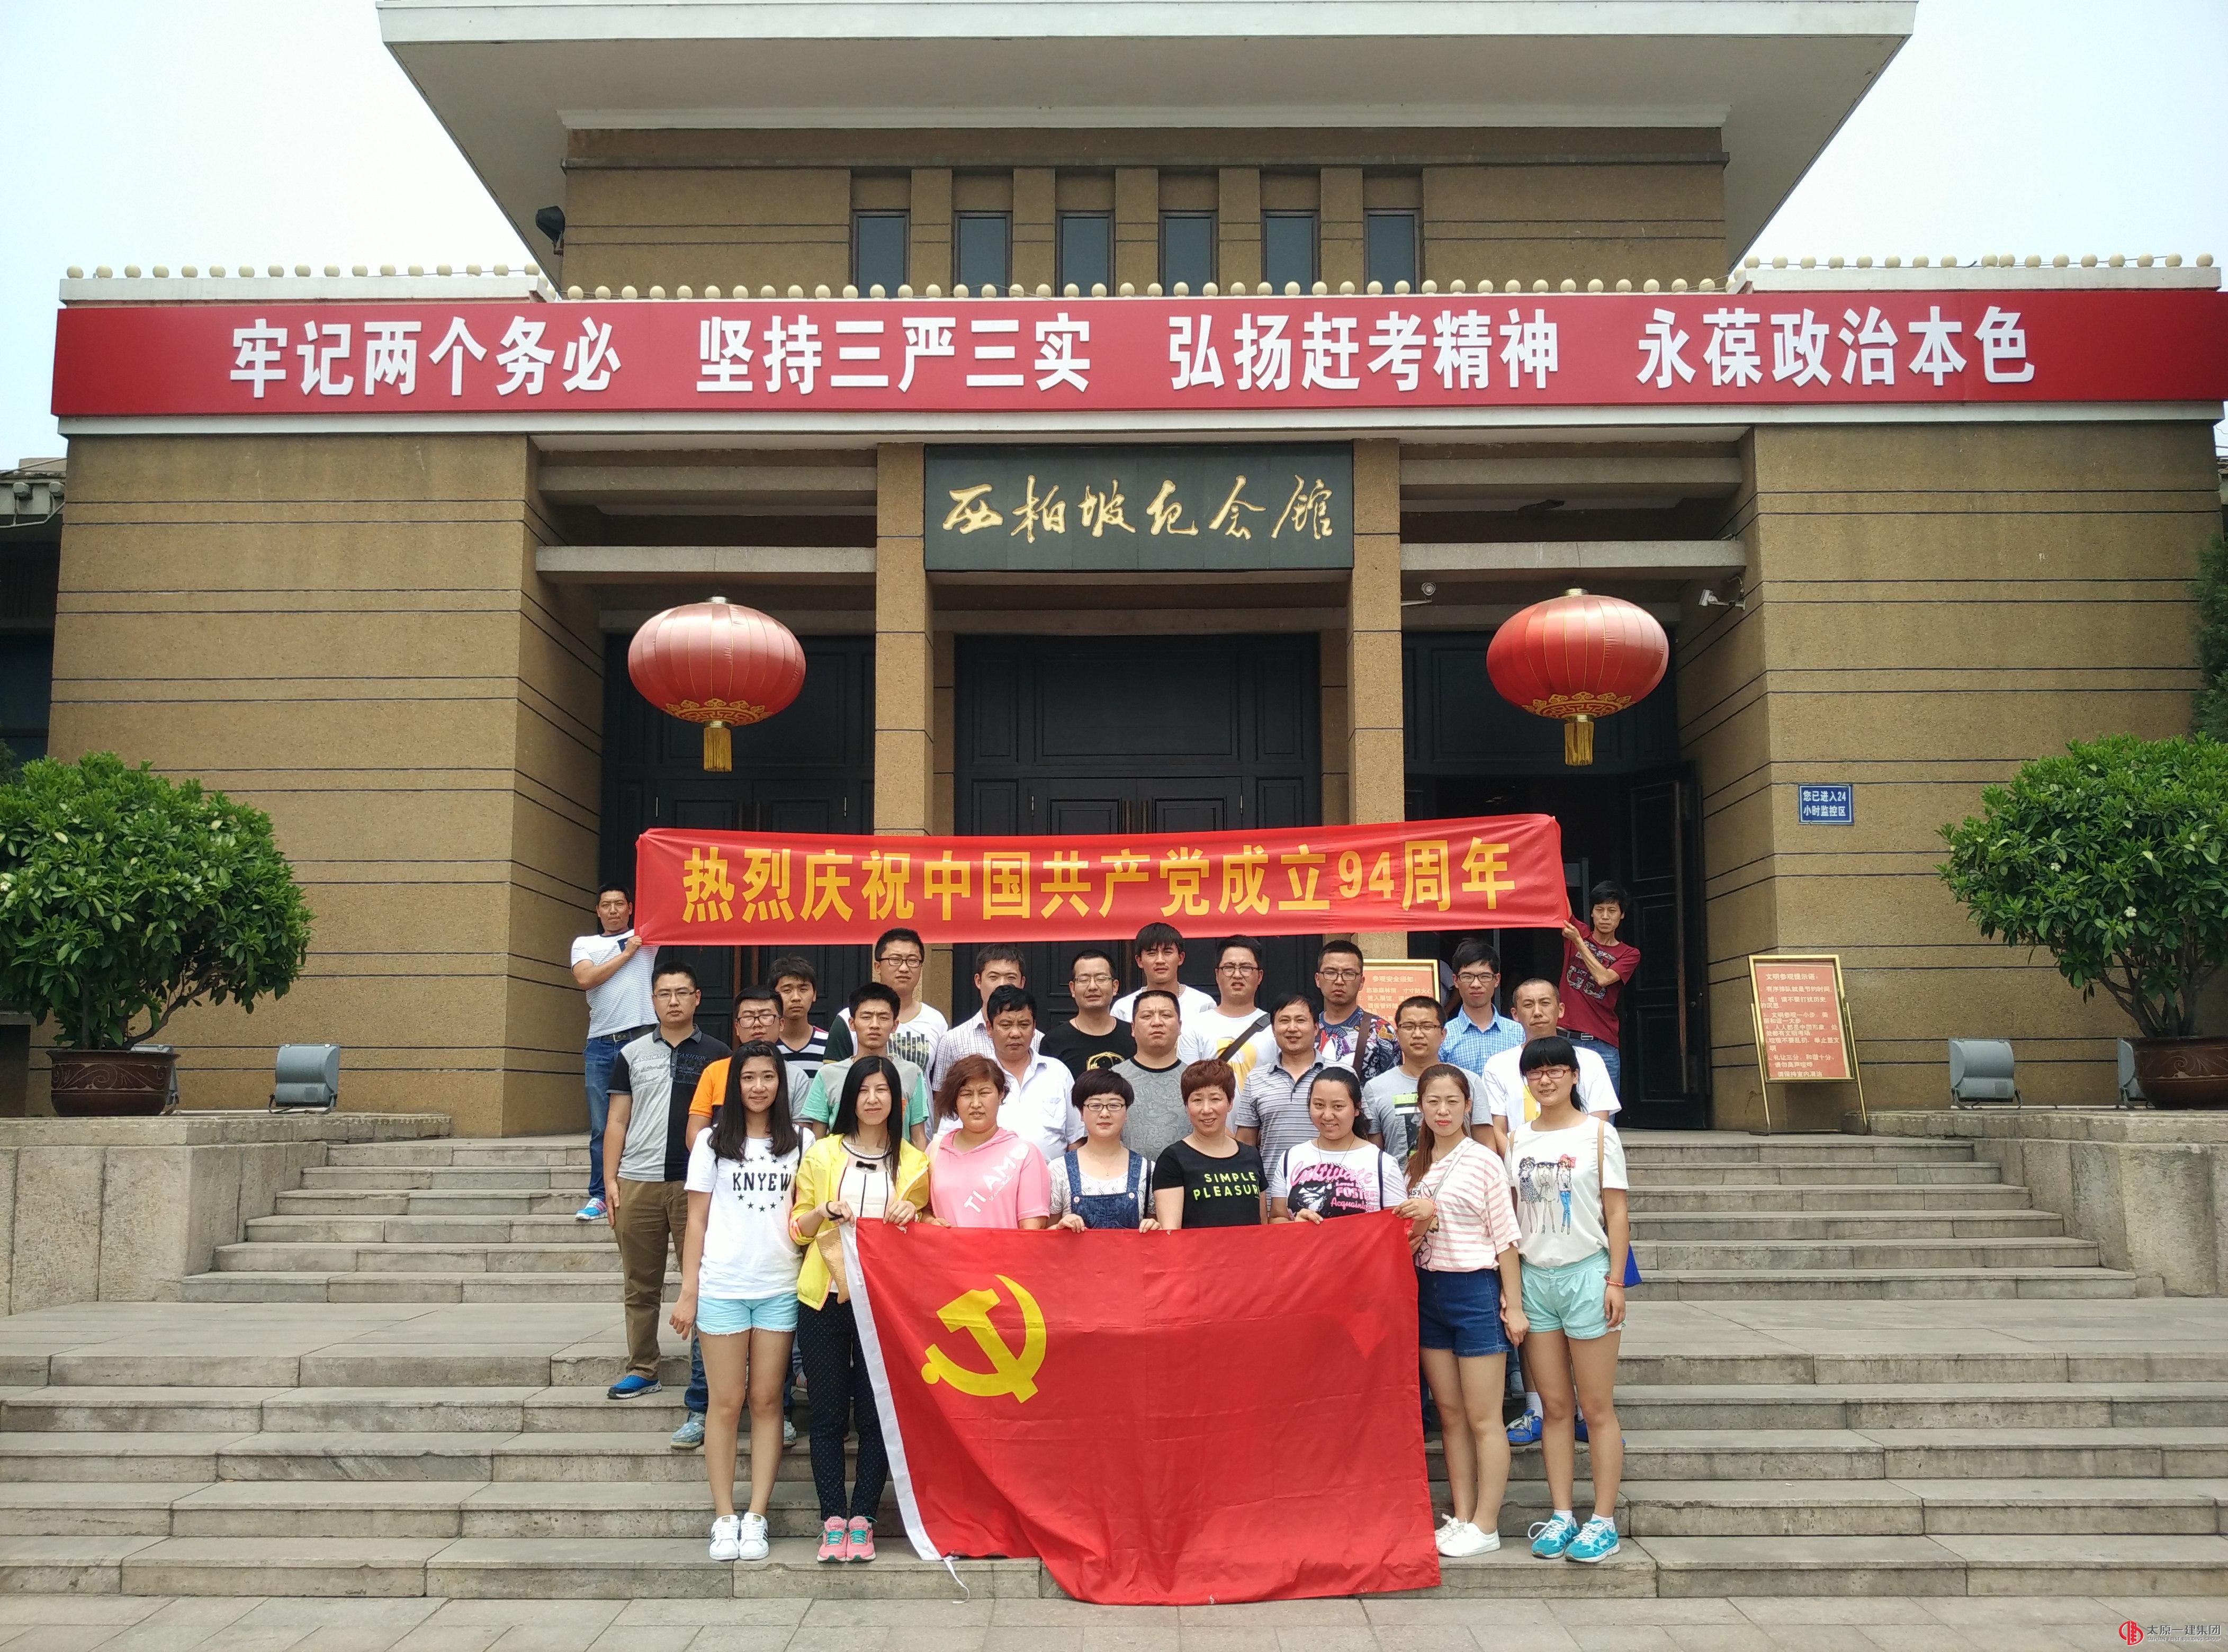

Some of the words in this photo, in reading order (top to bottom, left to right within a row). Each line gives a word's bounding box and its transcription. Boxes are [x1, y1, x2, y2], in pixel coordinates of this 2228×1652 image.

[230, 315, 622, 398] 牢记两个务必
[696, 312, 1091, 394] 坚持三严三实
[1168, 308, 1559, 392] 弘扬赶考精神
[1636, 305, 2035, 389] 永葆政治本色
[942, 474, 1334, 543] 西柏坡纪念馆
[1803, 791, 1846, 802] 您已进入24
[1803, 805, 1846, 816] 小时监控区
[682, 838, 1516, 922] 热烈庆祝中国共产党成立94周年
[733, 1172, 792, 1191] KNYEW
[1203, 1171, 1256, 1183] SIMPLE
[964, 1190, 986, 1213] TI
